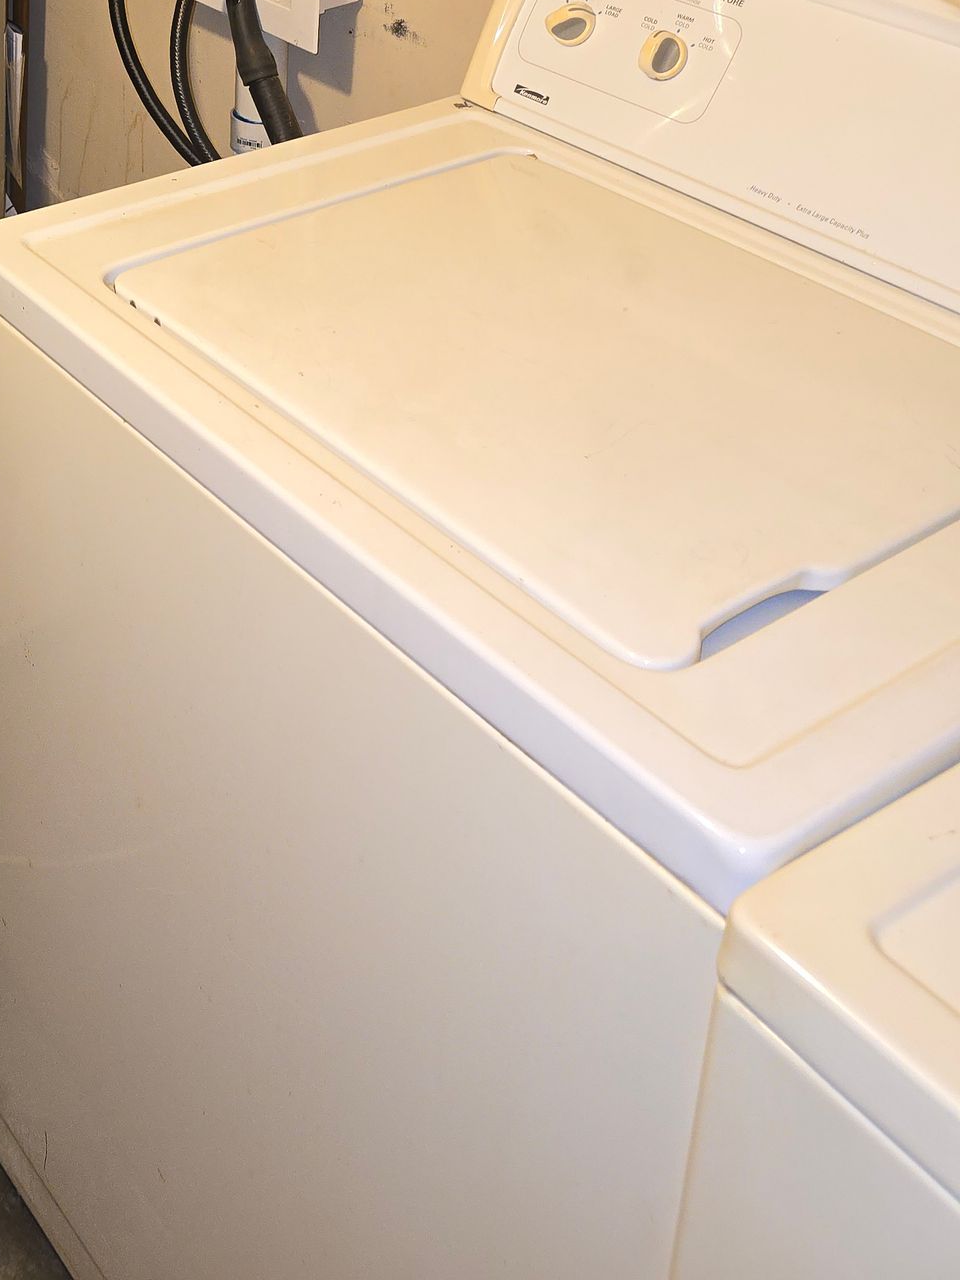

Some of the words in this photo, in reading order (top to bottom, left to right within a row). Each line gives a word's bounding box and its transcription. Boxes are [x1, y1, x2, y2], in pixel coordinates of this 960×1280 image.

[605, 4, 623, 14] LARGE
[604, 10, 619, 19] LOAD
[677, 13, 695, 23] WARM
[643, 16, 658, 25] COLD
[674, 20, 690, 30] COLD
[640, 22, 656, 32] COLD
[702, 36, 715, 44] HOT
[698, 42, 714, 52] COLD
[750, 184, 767, 198] Heavy
[767, 192, 782, 203] Duty
[795, 204, 812, 216] Extra
[811, 210, 829, 223] Large
[829, 217, 856, 234] Capacity
[855, 228, 870, 240] Plus
